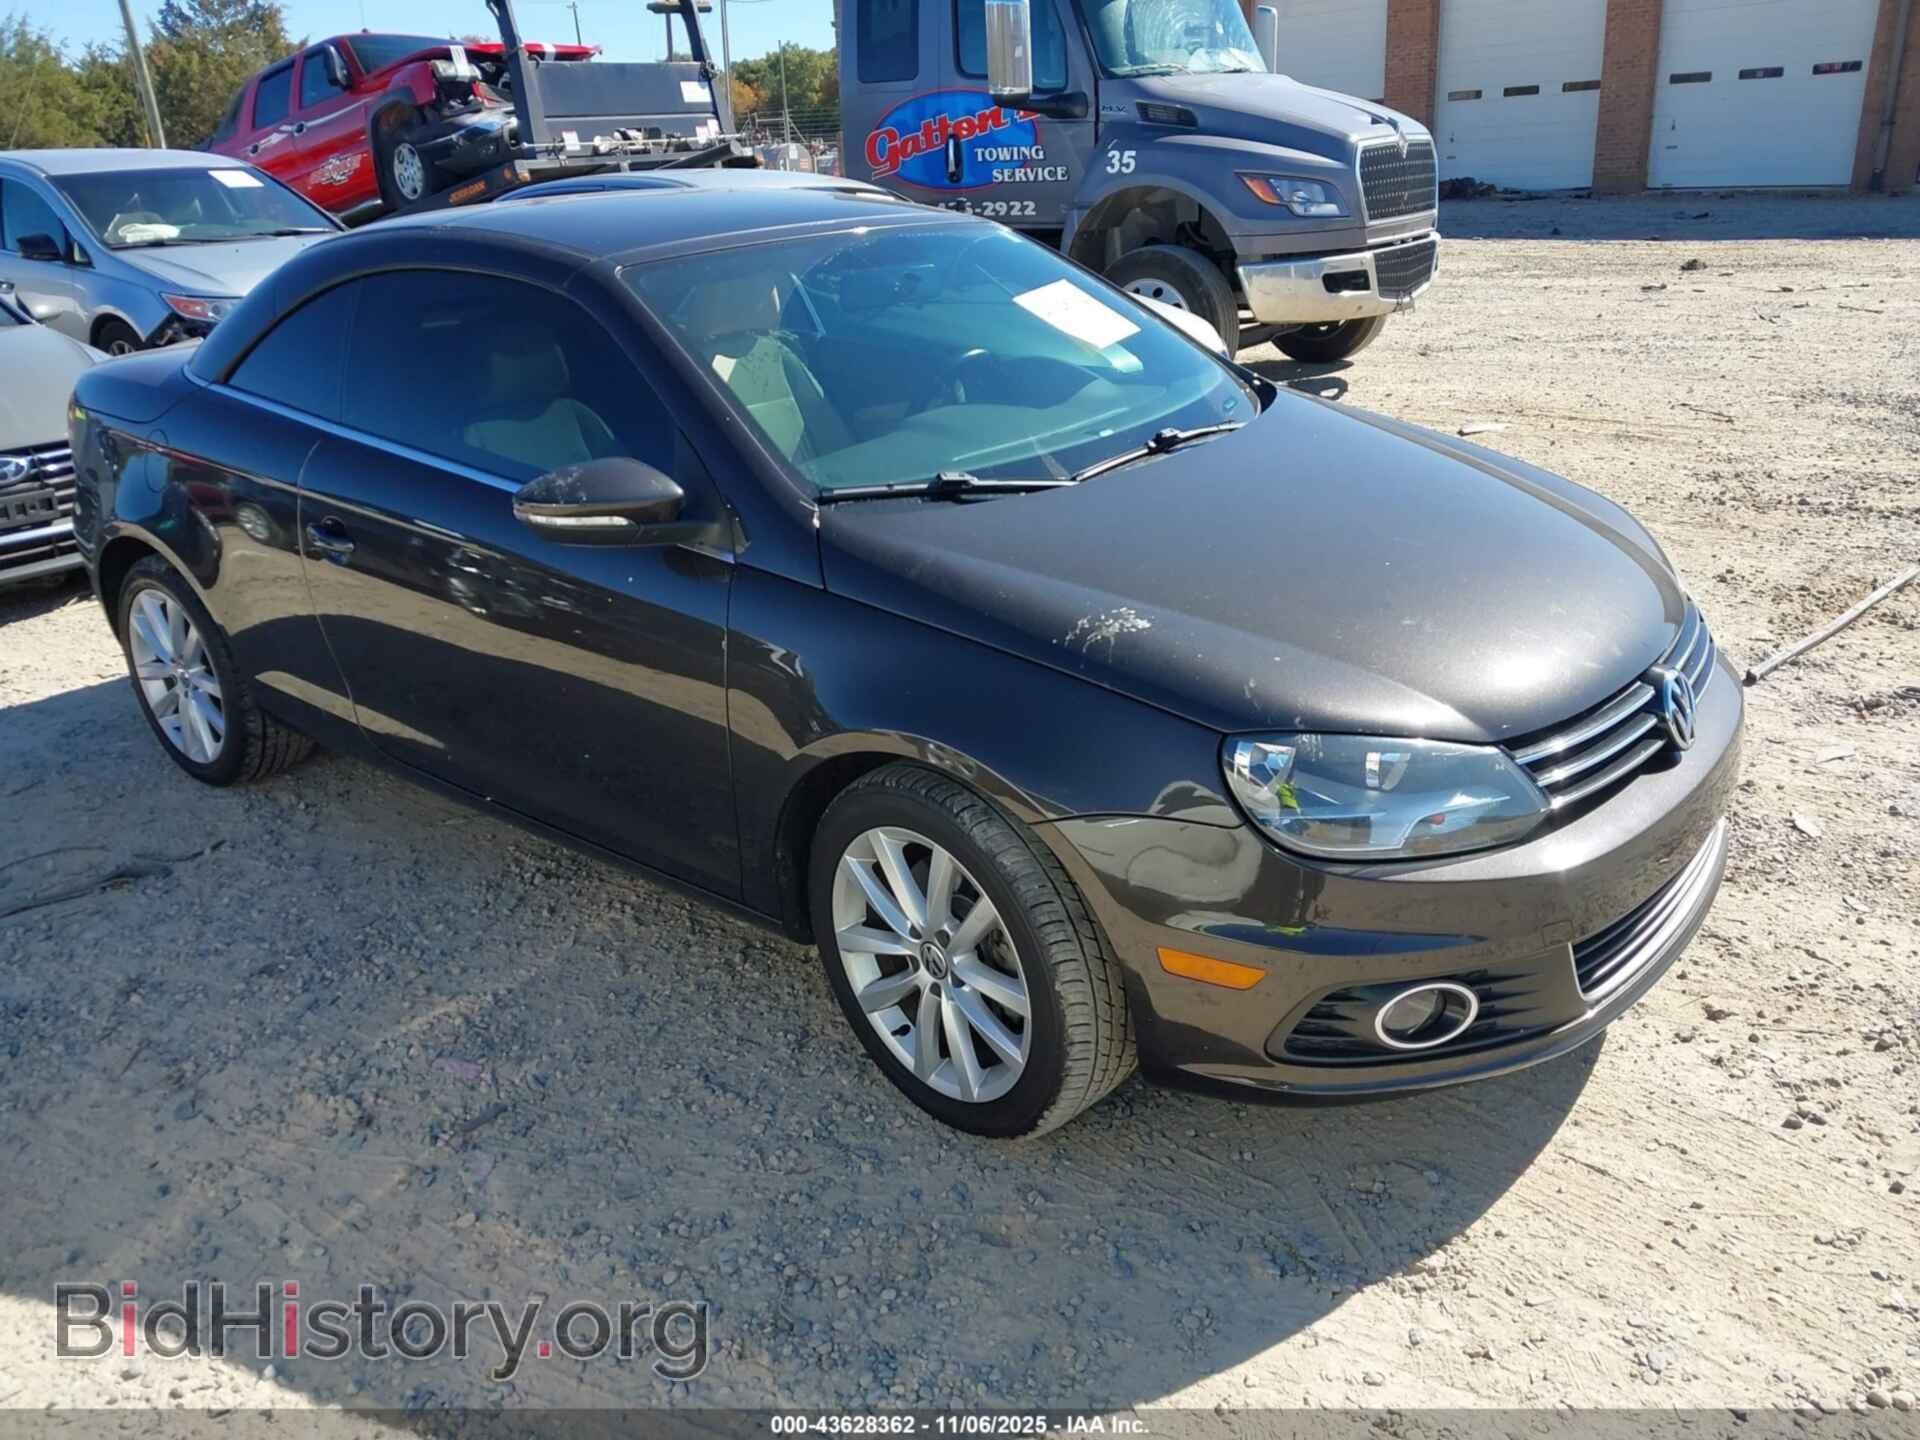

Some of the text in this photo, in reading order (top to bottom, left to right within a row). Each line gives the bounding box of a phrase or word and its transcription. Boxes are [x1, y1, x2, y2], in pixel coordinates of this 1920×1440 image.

[865, 105, 1040, 180] Gatton
[974, 145, 1044, 162] TOWING
[1106, 150, 1137, 173] 35
[992, 166, 1068, 182] SERVICE
